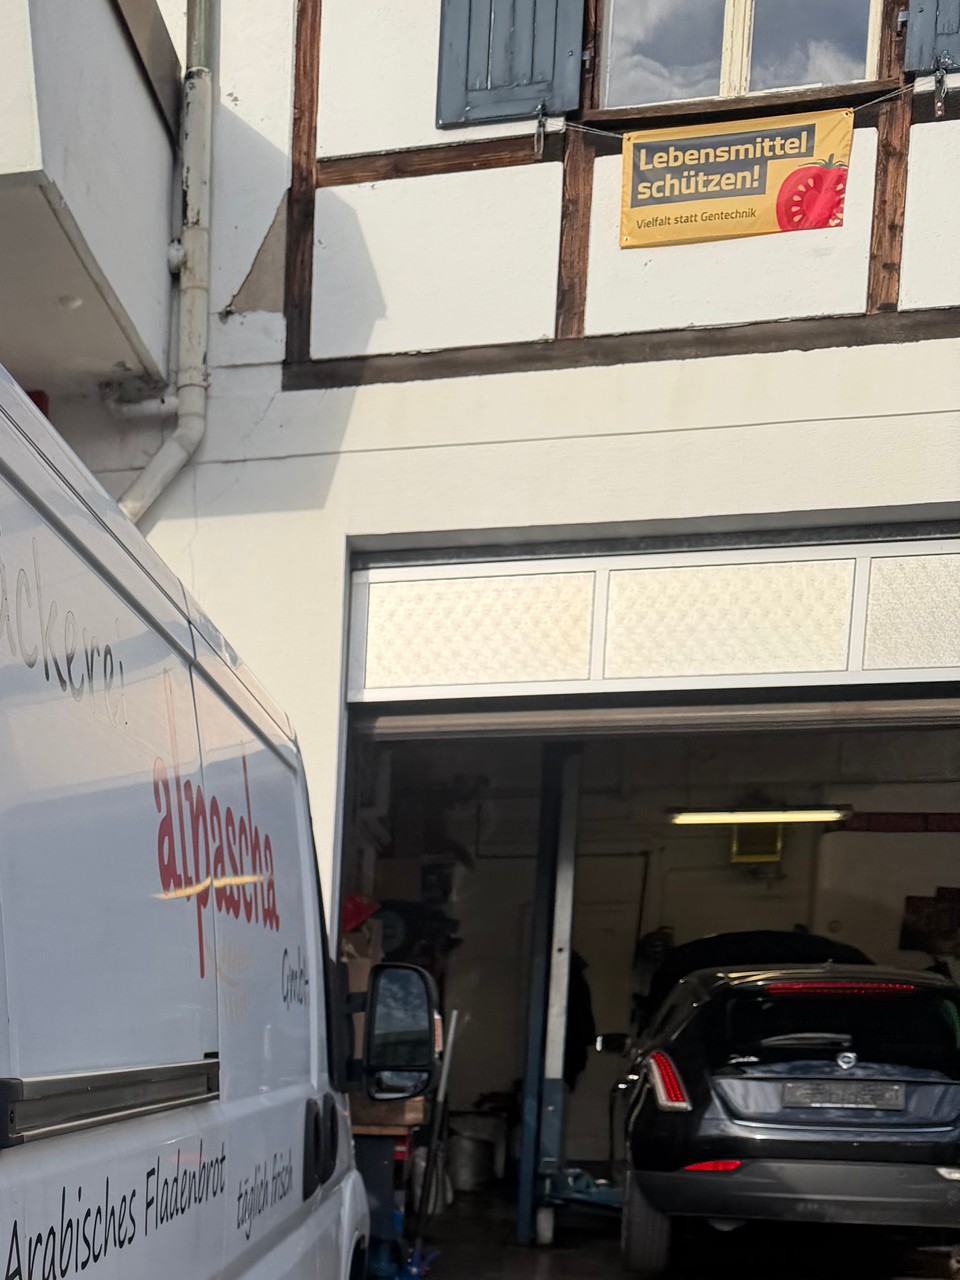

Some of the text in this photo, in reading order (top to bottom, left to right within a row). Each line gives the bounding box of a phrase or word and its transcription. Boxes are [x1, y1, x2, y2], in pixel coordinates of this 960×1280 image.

[639, 131, 808, 171] Lebensmittel
[637, 165, 760, 200] schützen!
[636, 208, 757, 230] Vielfalt statt Gentechnik
[153, 667, 280, 979] alpascha
[145, 1138, 226, 1236] Fladenbrot
